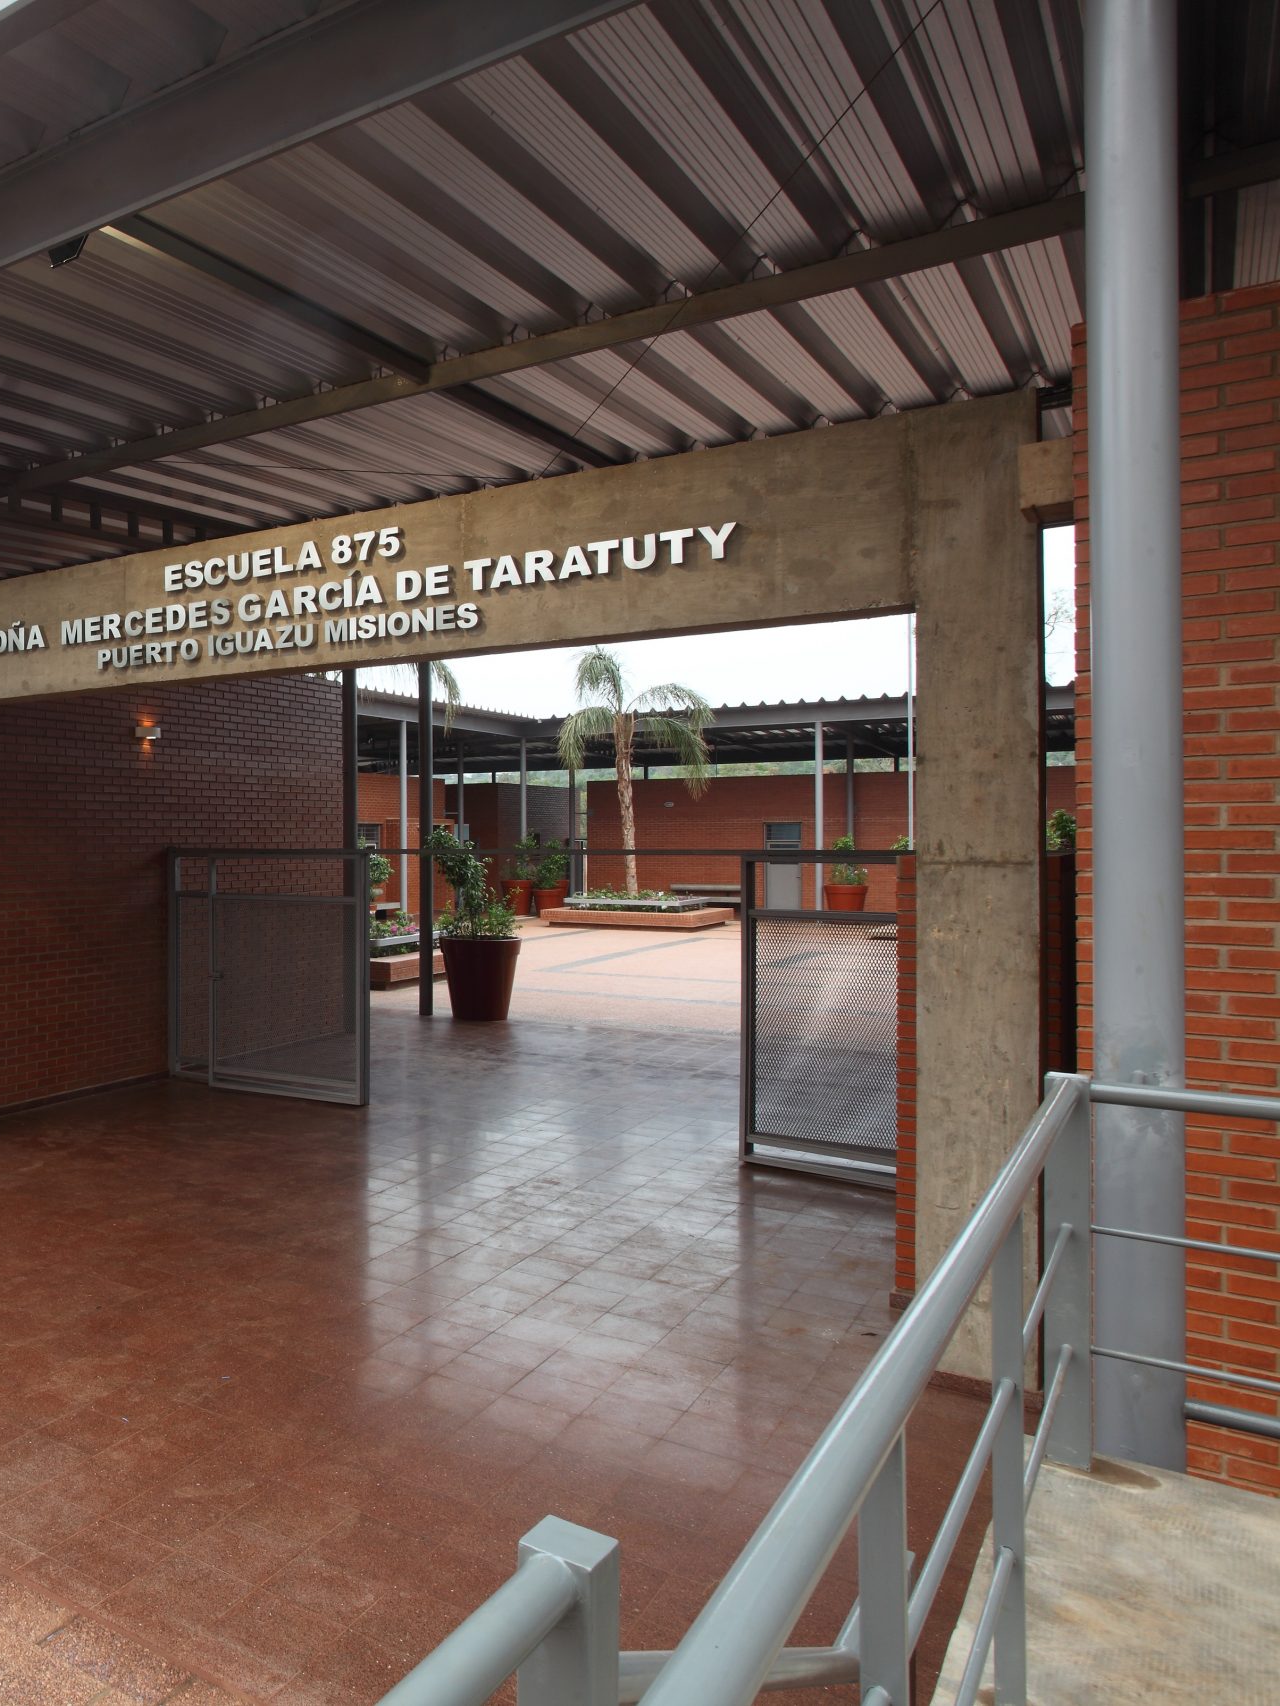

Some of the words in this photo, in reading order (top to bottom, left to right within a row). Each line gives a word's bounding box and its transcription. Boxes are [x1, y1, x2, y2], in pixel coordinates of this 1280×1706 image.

[60, 599, 230, 645] MERCEDES
[237, 570, 382, 622] GARCÍA
[396, 565, 449, 601] DE
[463, 522, 737, 591] TARATUTY
[164, 541, 321, 592] ESCUELA
[331, 526, 400, 564] 875
[97, 638, 198, 670] PUERTO
[207, 623, 314, 657] IGUAZU
[324, 603, 479, 644] MISIONES
